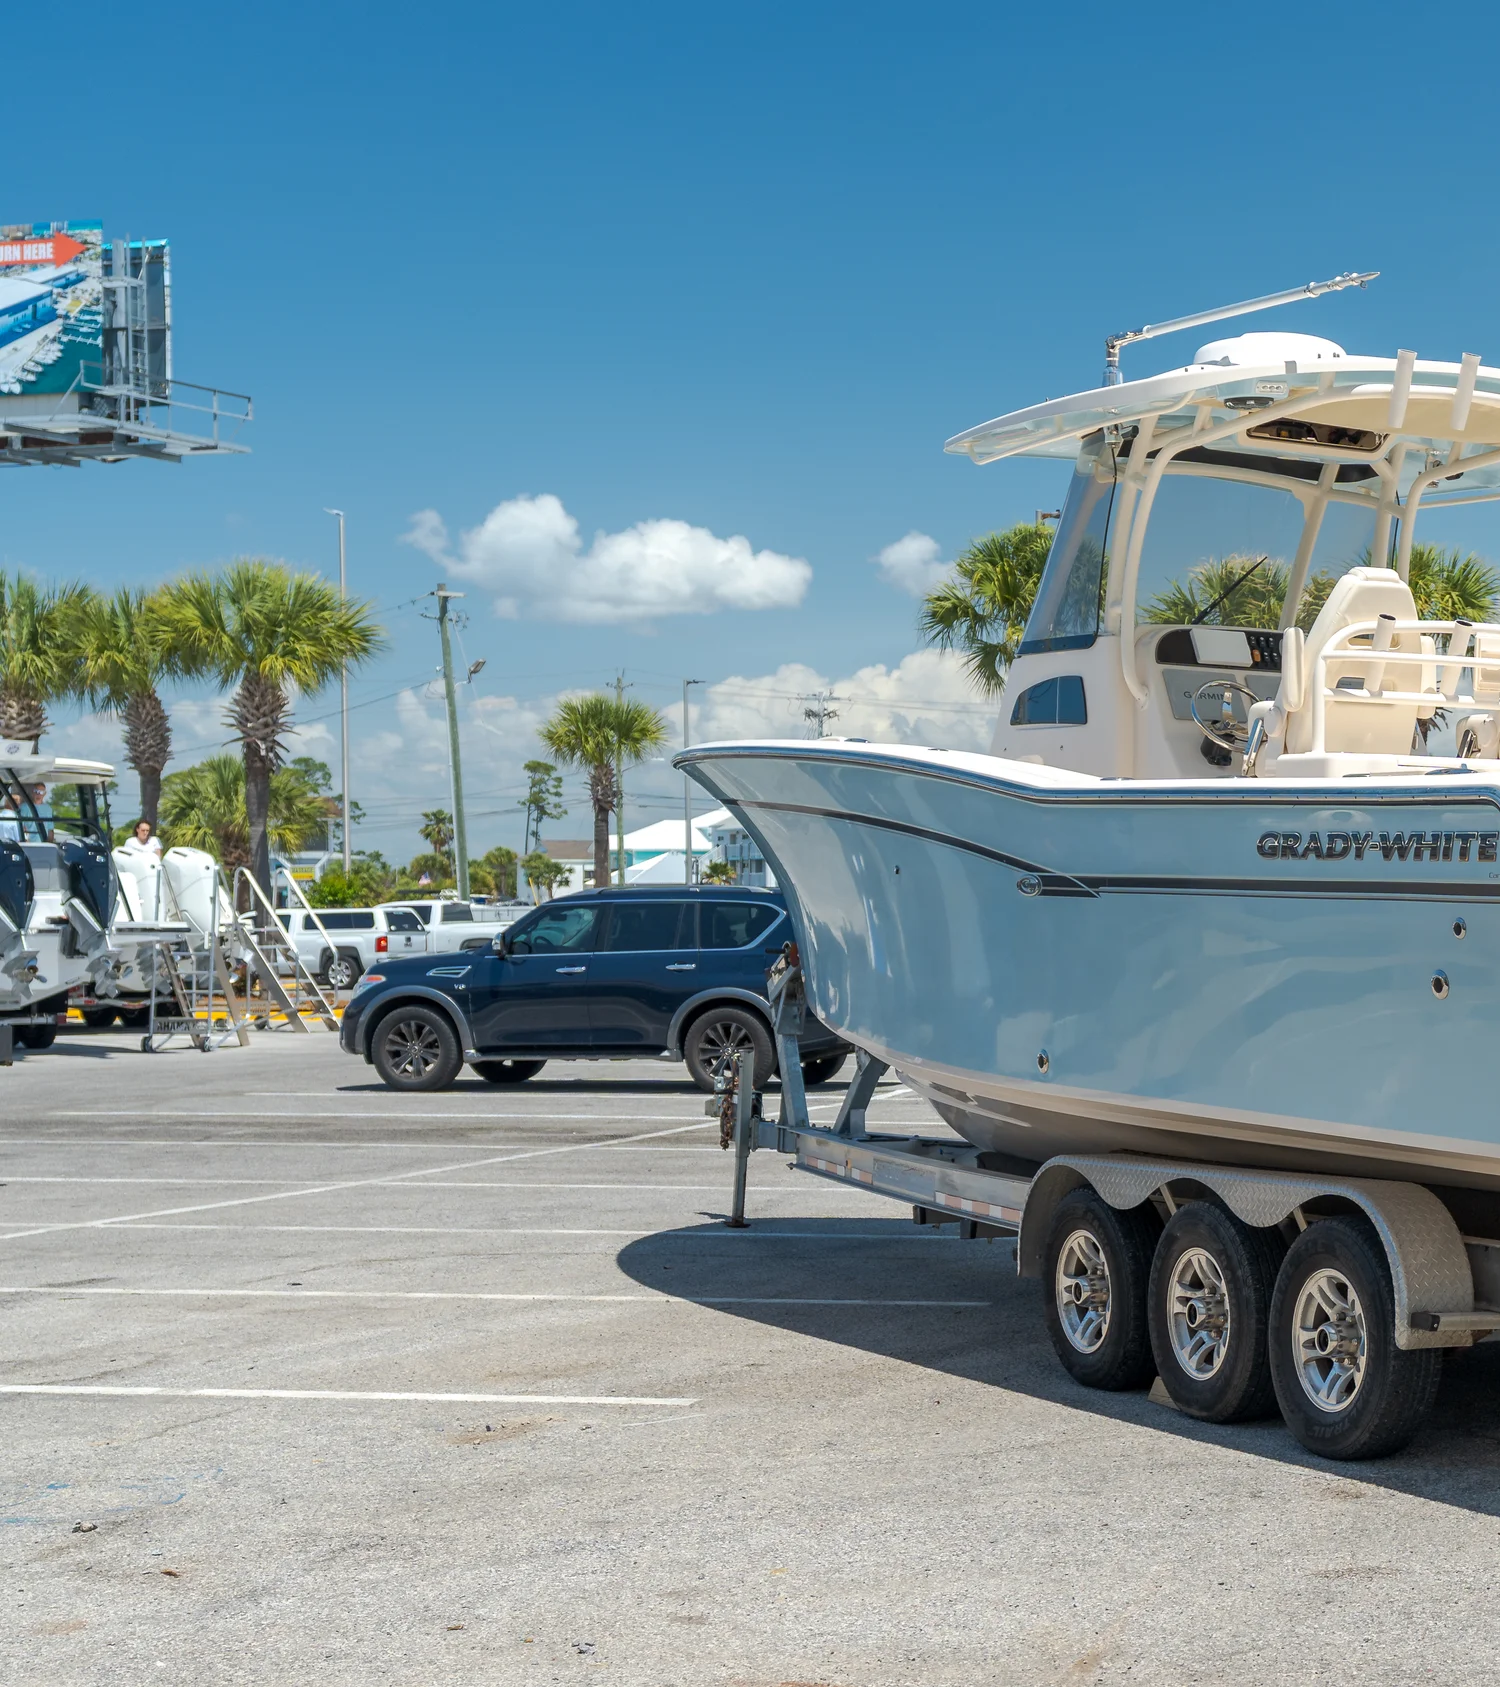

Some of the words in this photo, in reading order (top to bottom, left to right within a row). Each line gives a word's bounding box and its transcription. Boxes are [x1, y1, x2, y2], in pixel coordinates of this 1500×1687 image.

[23, 242, 53, 260] HERE
[1184, 691, 1225, 701] GRMIN
[1256, 831, 1500, 862] GRADY-WHITE
